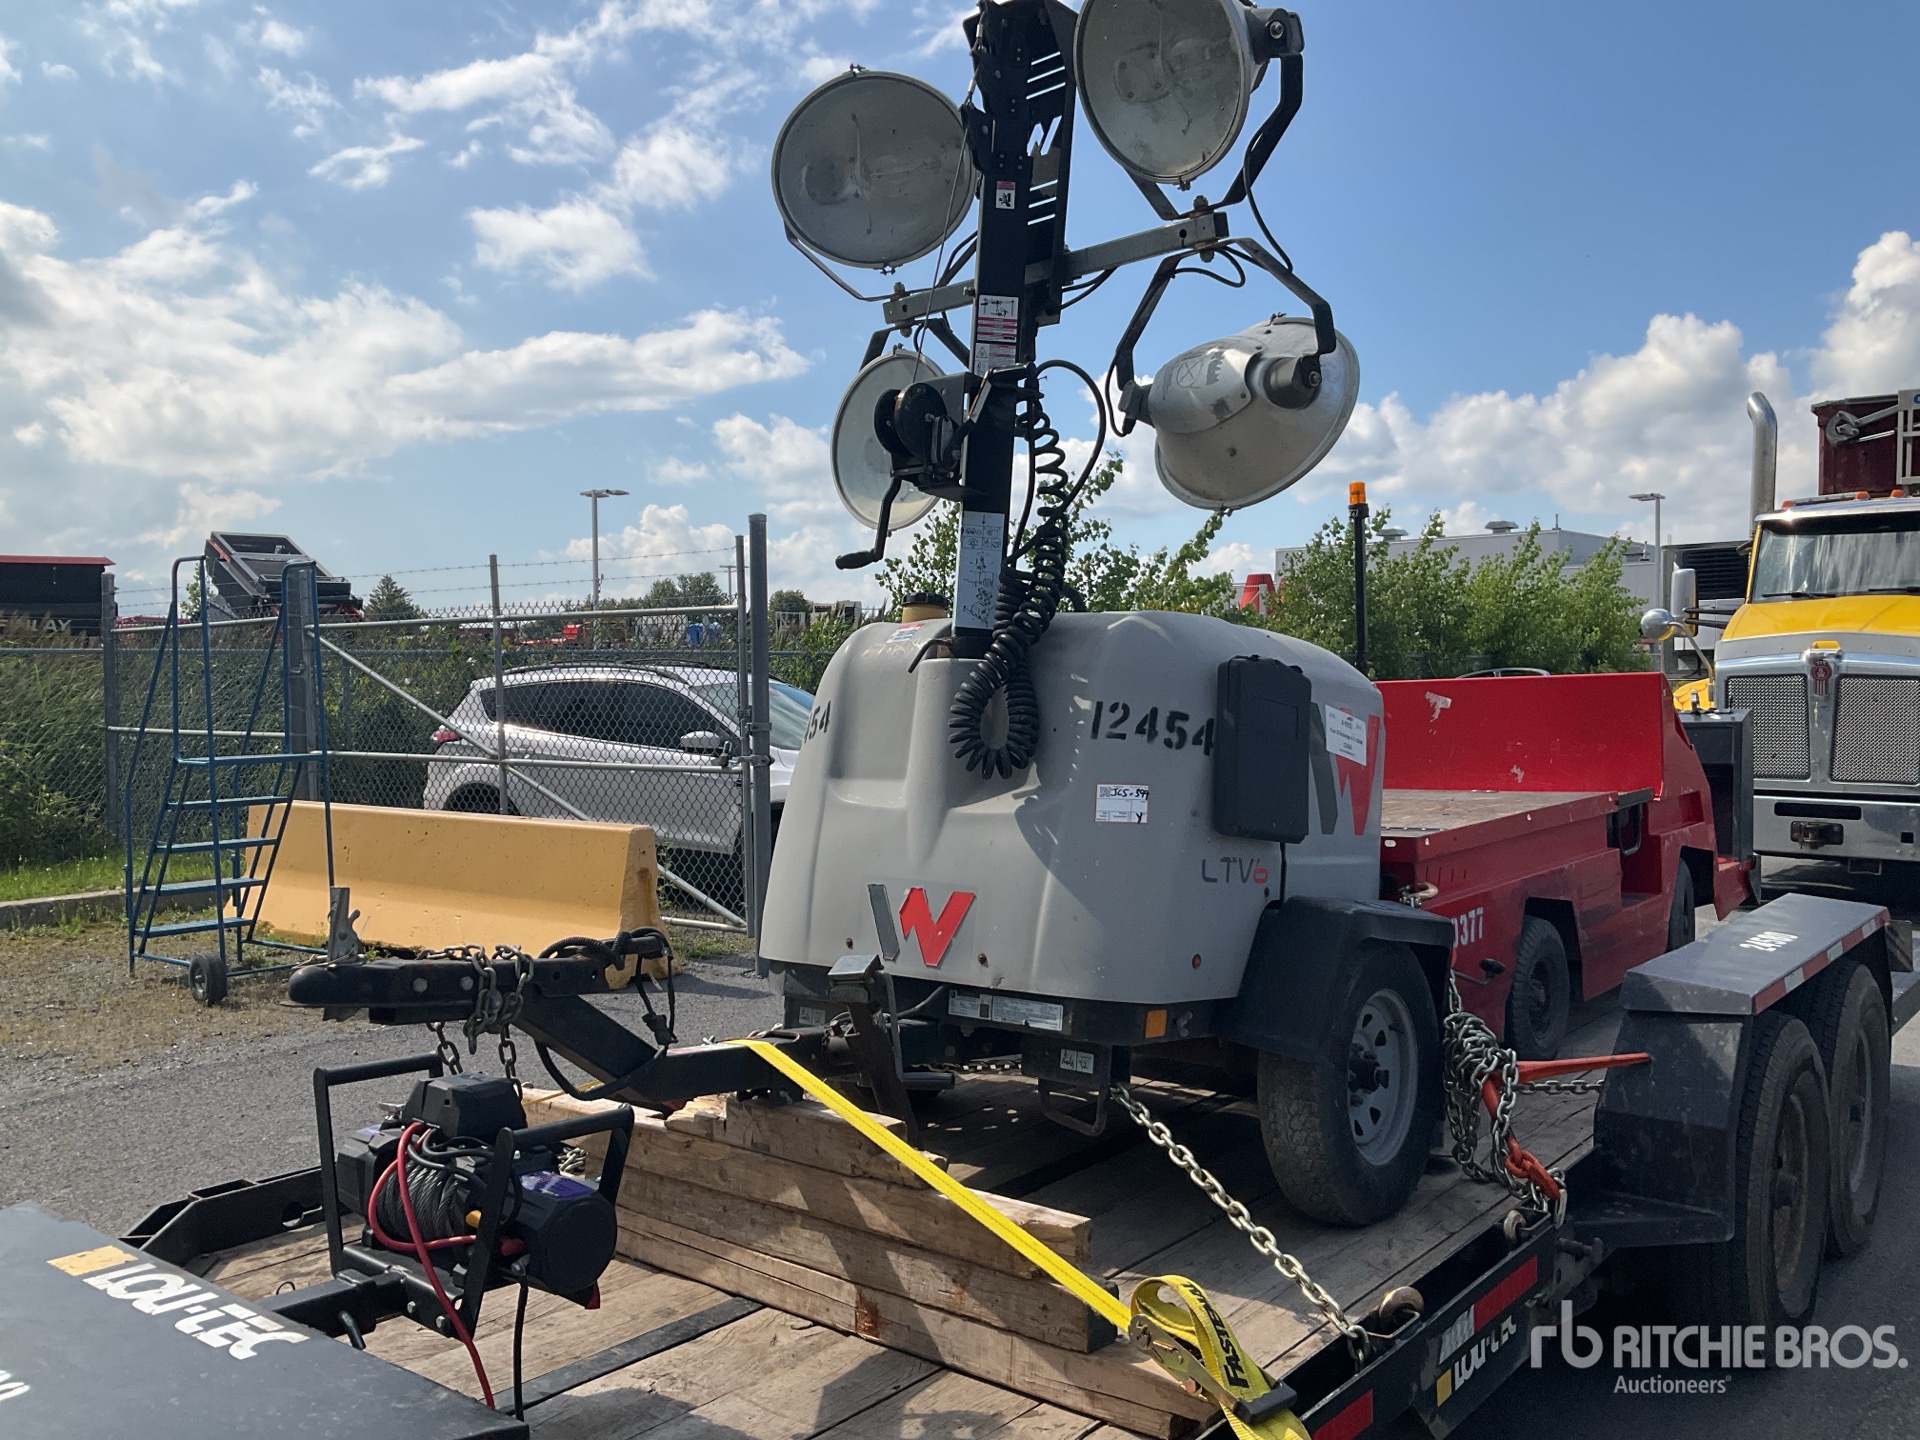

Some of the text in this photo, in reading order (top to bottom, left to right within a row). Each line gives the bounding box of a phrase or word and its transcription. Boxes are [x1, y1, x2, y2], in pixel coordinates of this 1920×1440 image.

[0, 619, 72, 633] FLAY
[804, 700, 831, 744] 54
[1091, 700, 1214, 756] 12454
[1201, 857, 1268, 884] LTV6
